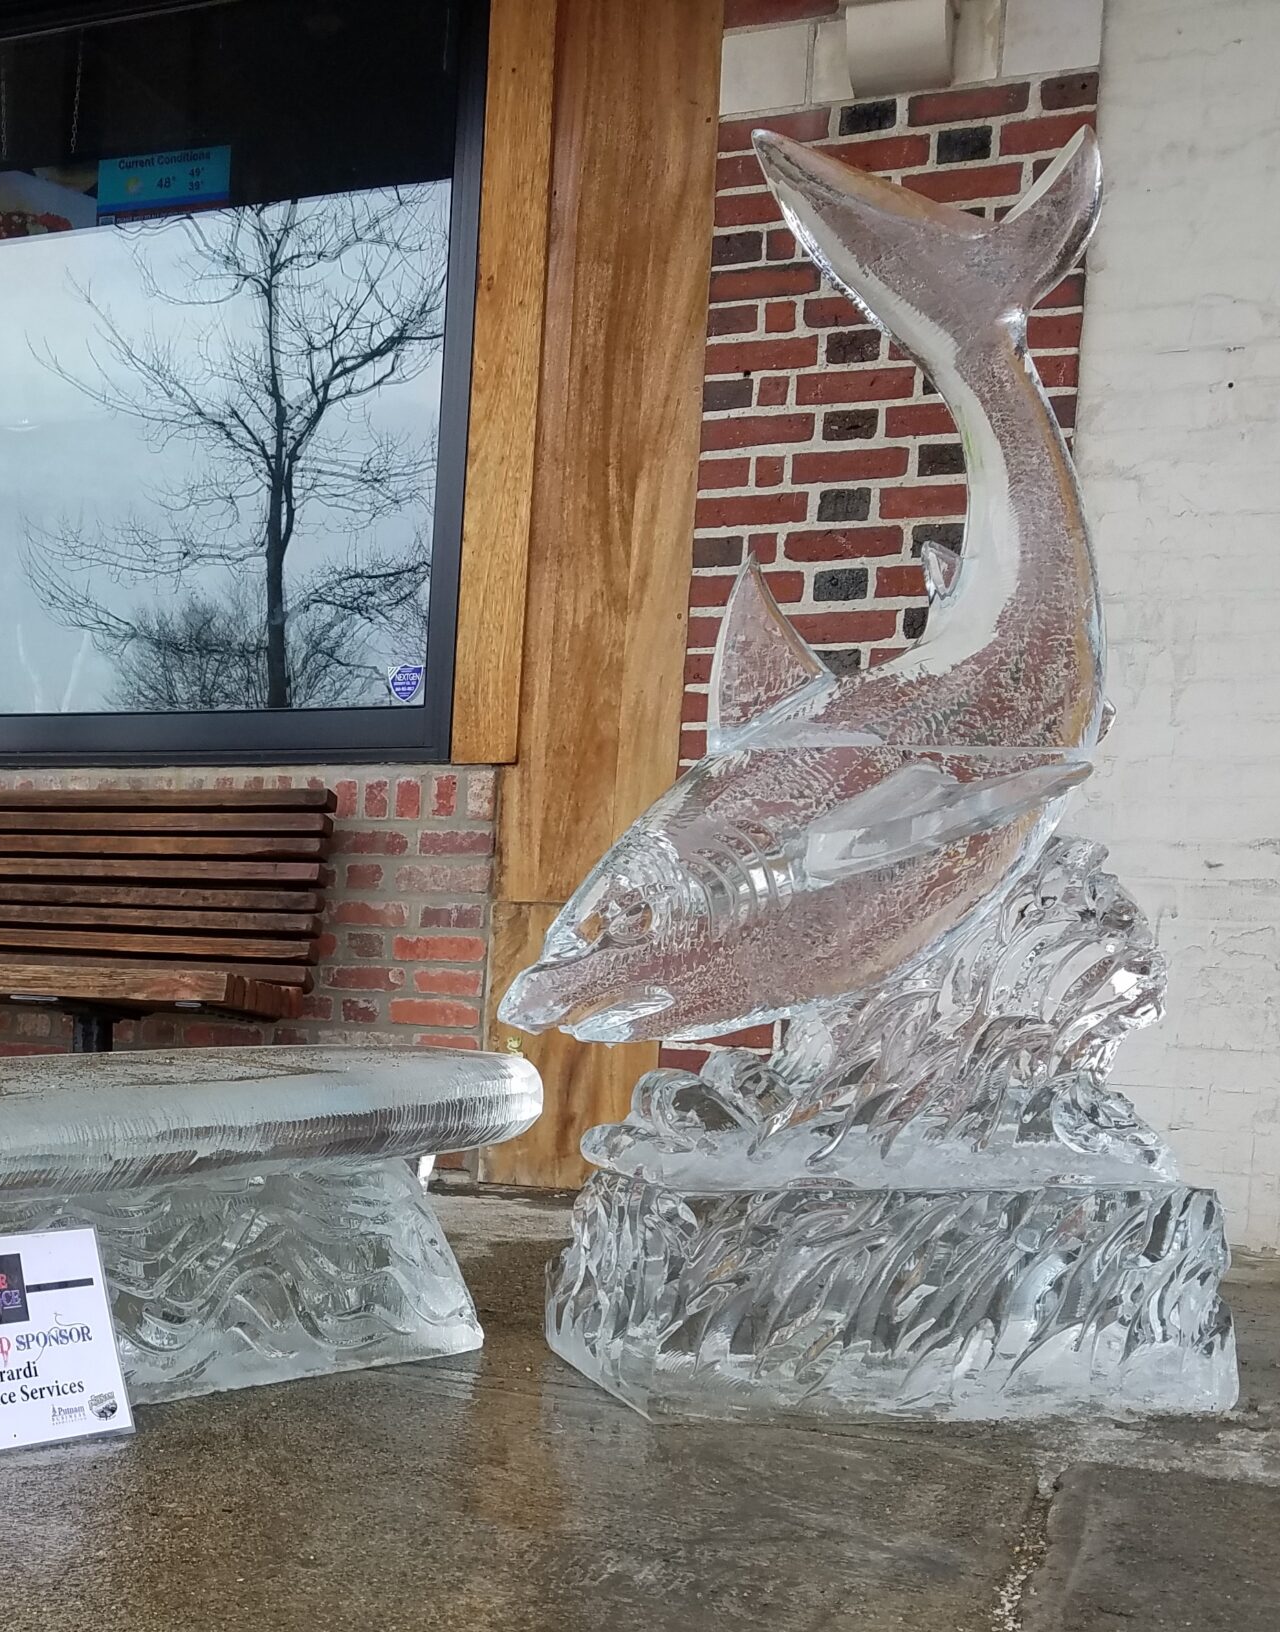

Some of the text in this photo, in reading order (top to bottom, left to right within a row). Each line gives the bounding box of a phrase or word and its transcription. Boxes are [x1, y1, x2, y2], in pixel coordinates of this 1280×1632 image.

[118, 151, 211, 170] Current Conditions
[16, 1325, 93, 1352] SPONSOR
[20, 1380, 85, 1402] Services
[57, 1405, 86, 1416] Putnam
